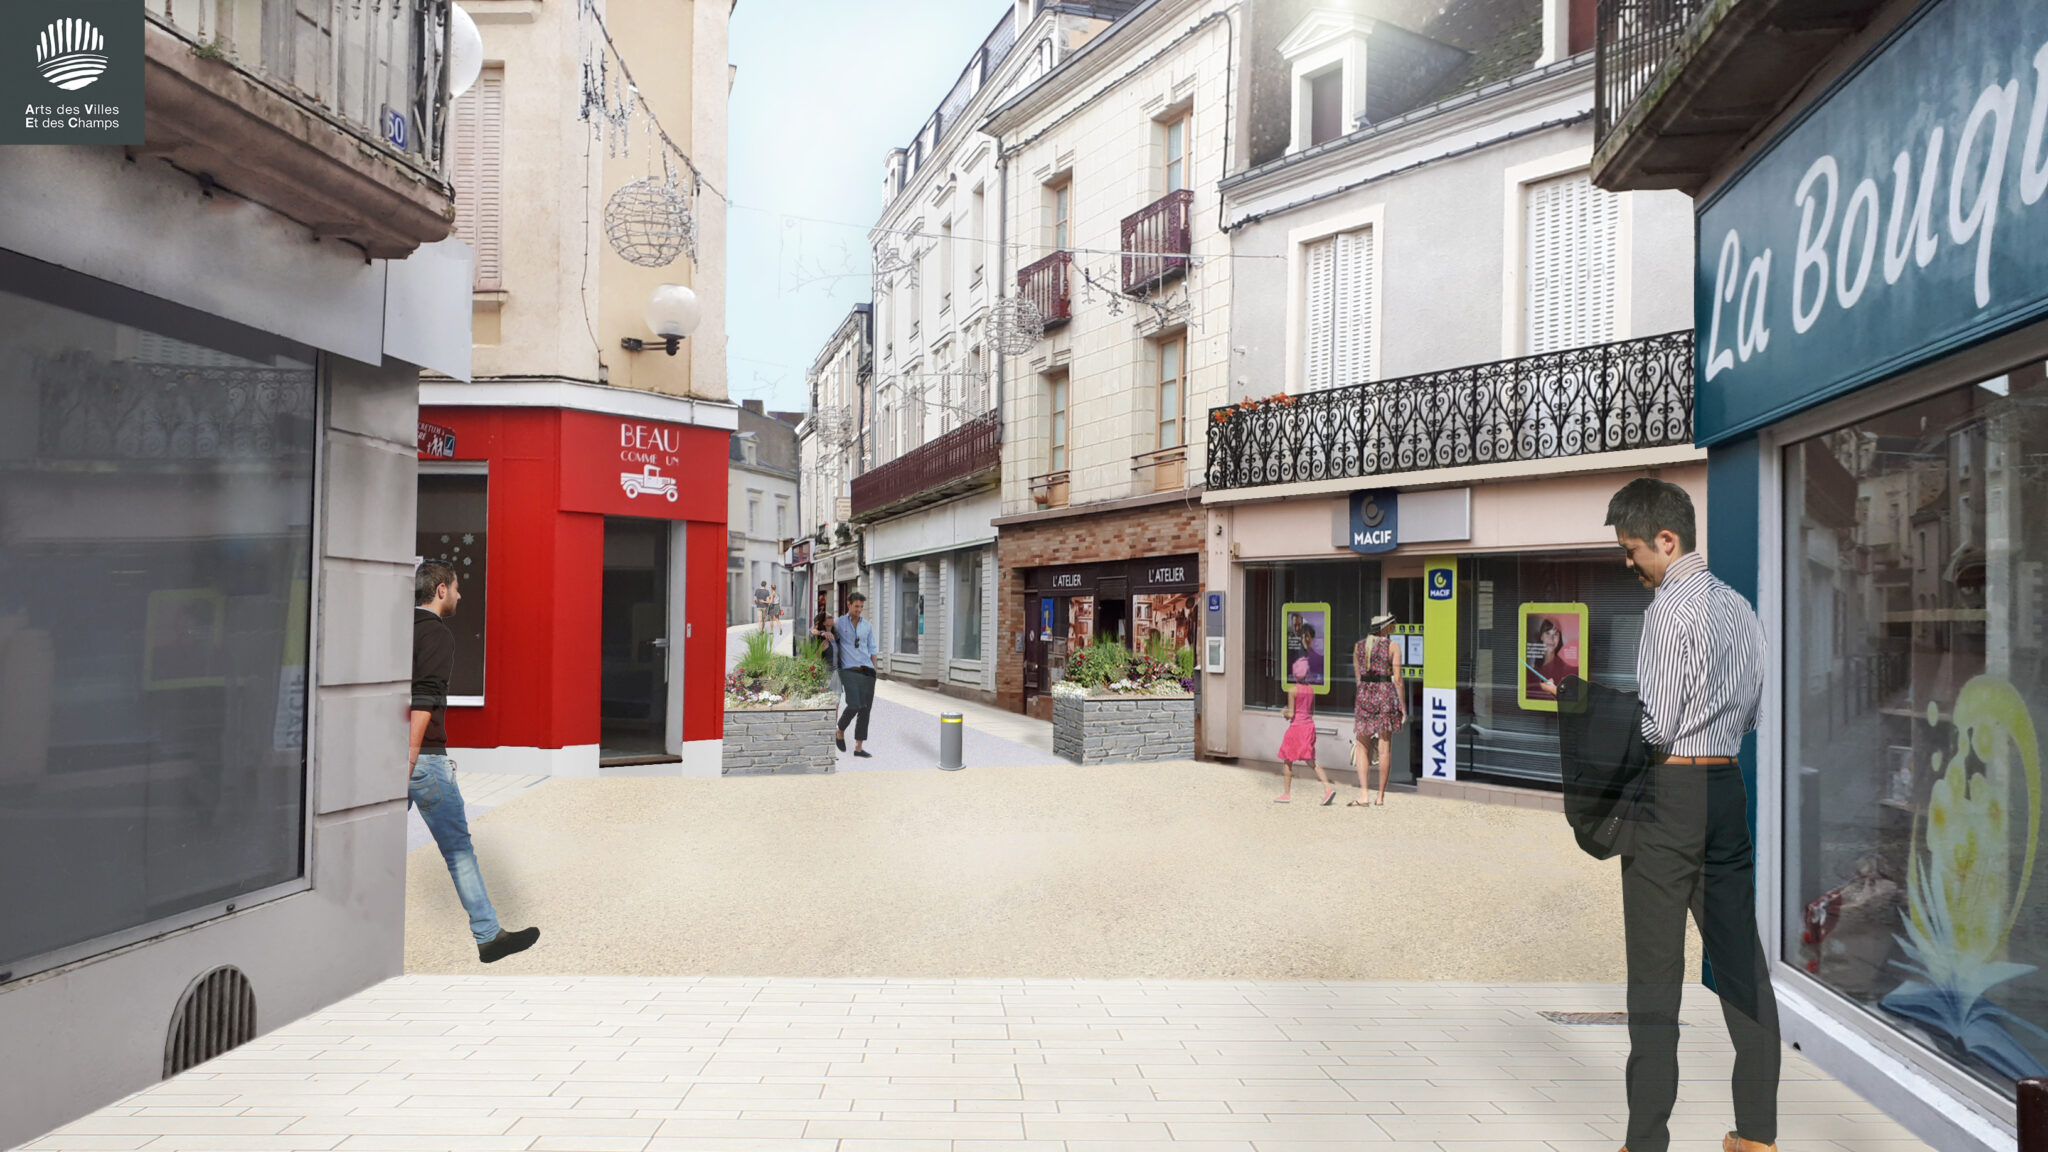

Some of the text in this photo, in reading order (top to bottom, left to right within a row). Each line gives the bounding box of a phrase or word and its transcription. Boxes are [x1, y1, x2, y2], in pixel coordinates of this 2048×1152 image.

[1704, 228, 1773, 382] La
[620, 423, 680, 453] BEAU
[620, 450, 680, 467] COMME UN
[1353, 529, 1392, 546] MACIF
[1430, 588, 1451, 597] MACIF
[1431, 696, 1447, 777] MACIF
